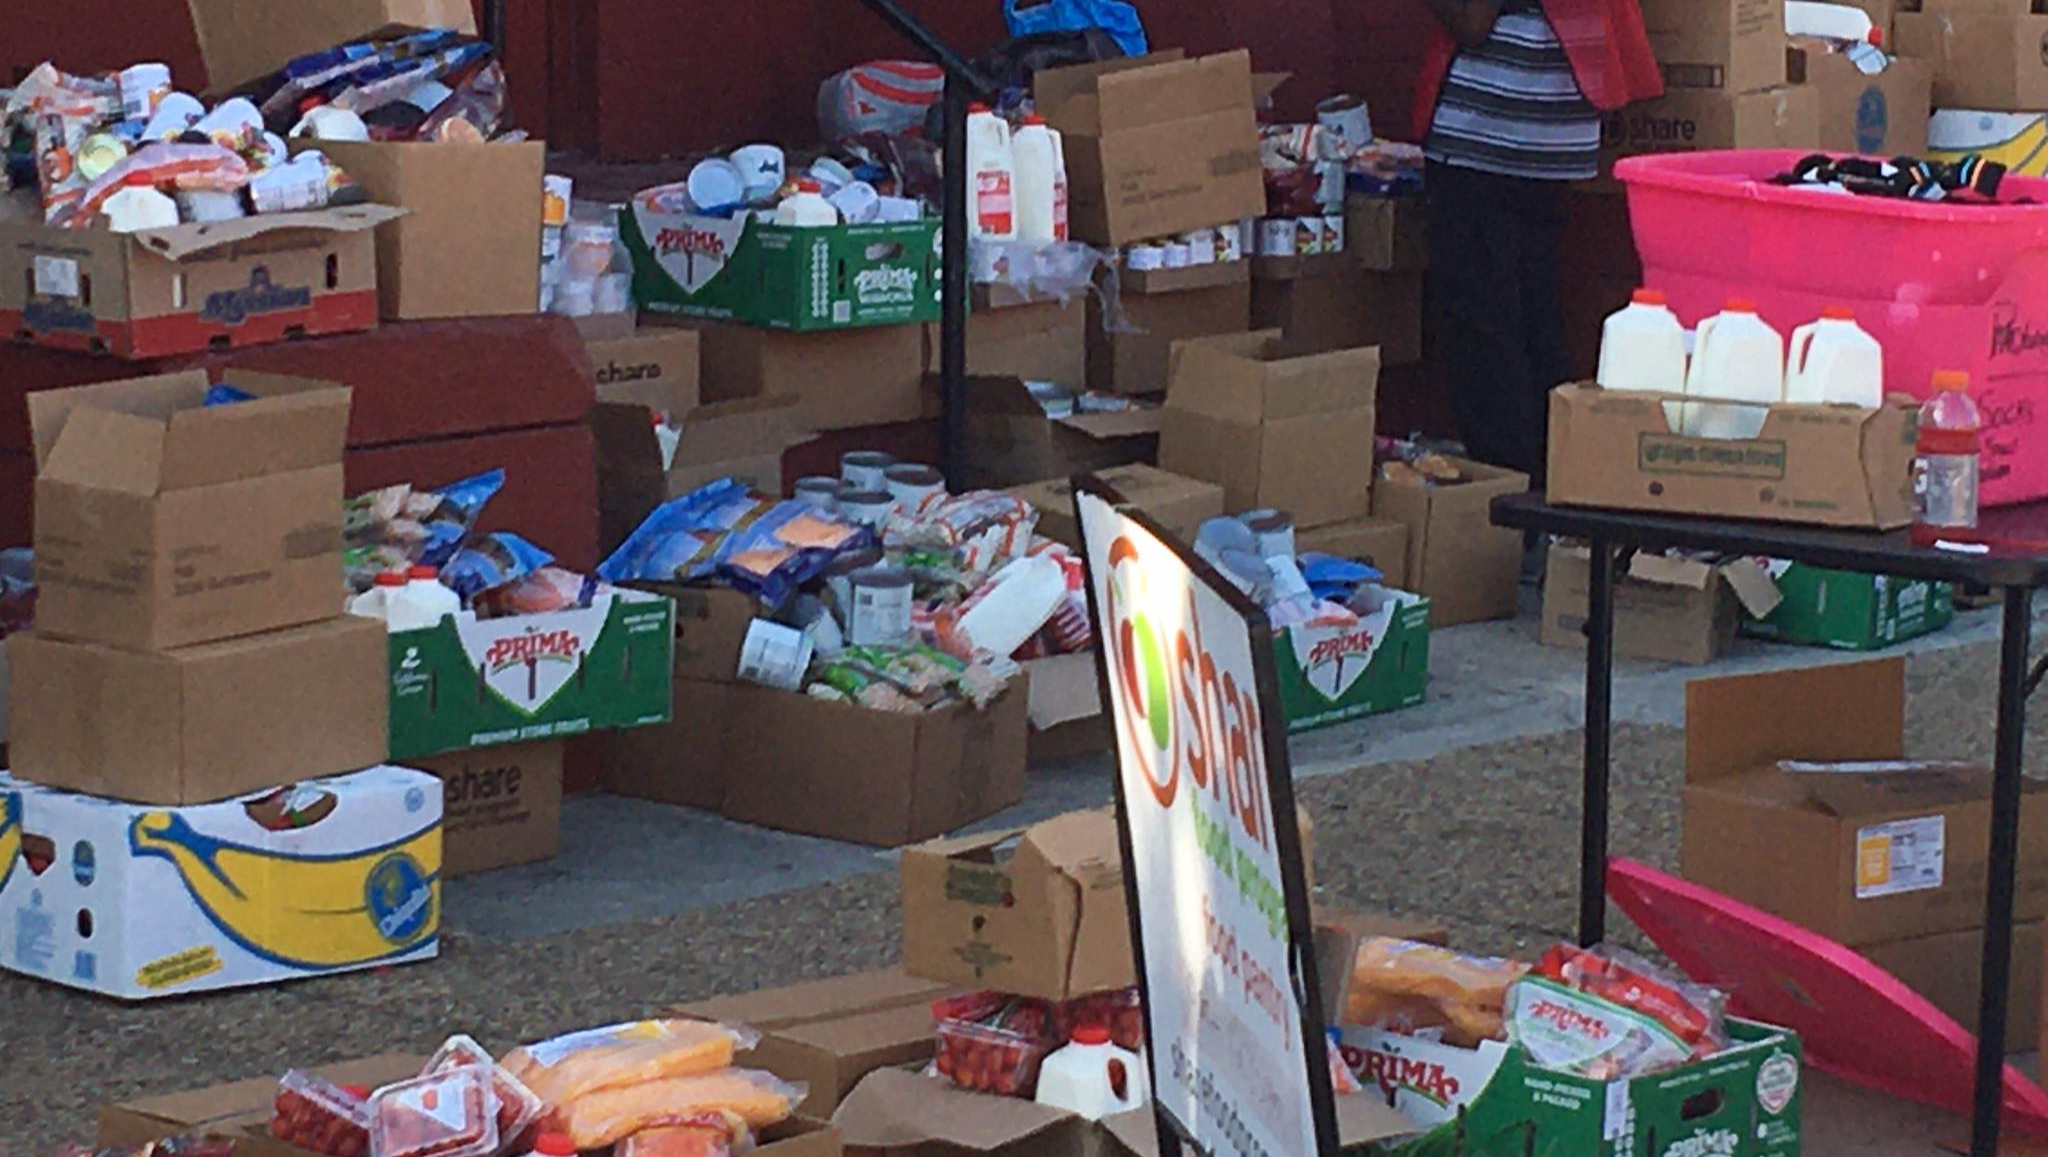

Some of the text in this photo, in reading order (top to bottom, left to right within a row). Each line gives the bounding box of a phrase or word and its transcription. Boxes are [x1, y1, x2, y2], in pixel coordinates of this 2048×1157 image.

[1629, 113, 1696, 142] share
[485, 630, 579, 669] PRIMA
[1309, 631, 1374, 665] PRIMA
[446, 765, 522, 803] share
[1529, 1000, 1610, 1040] PRIMA
